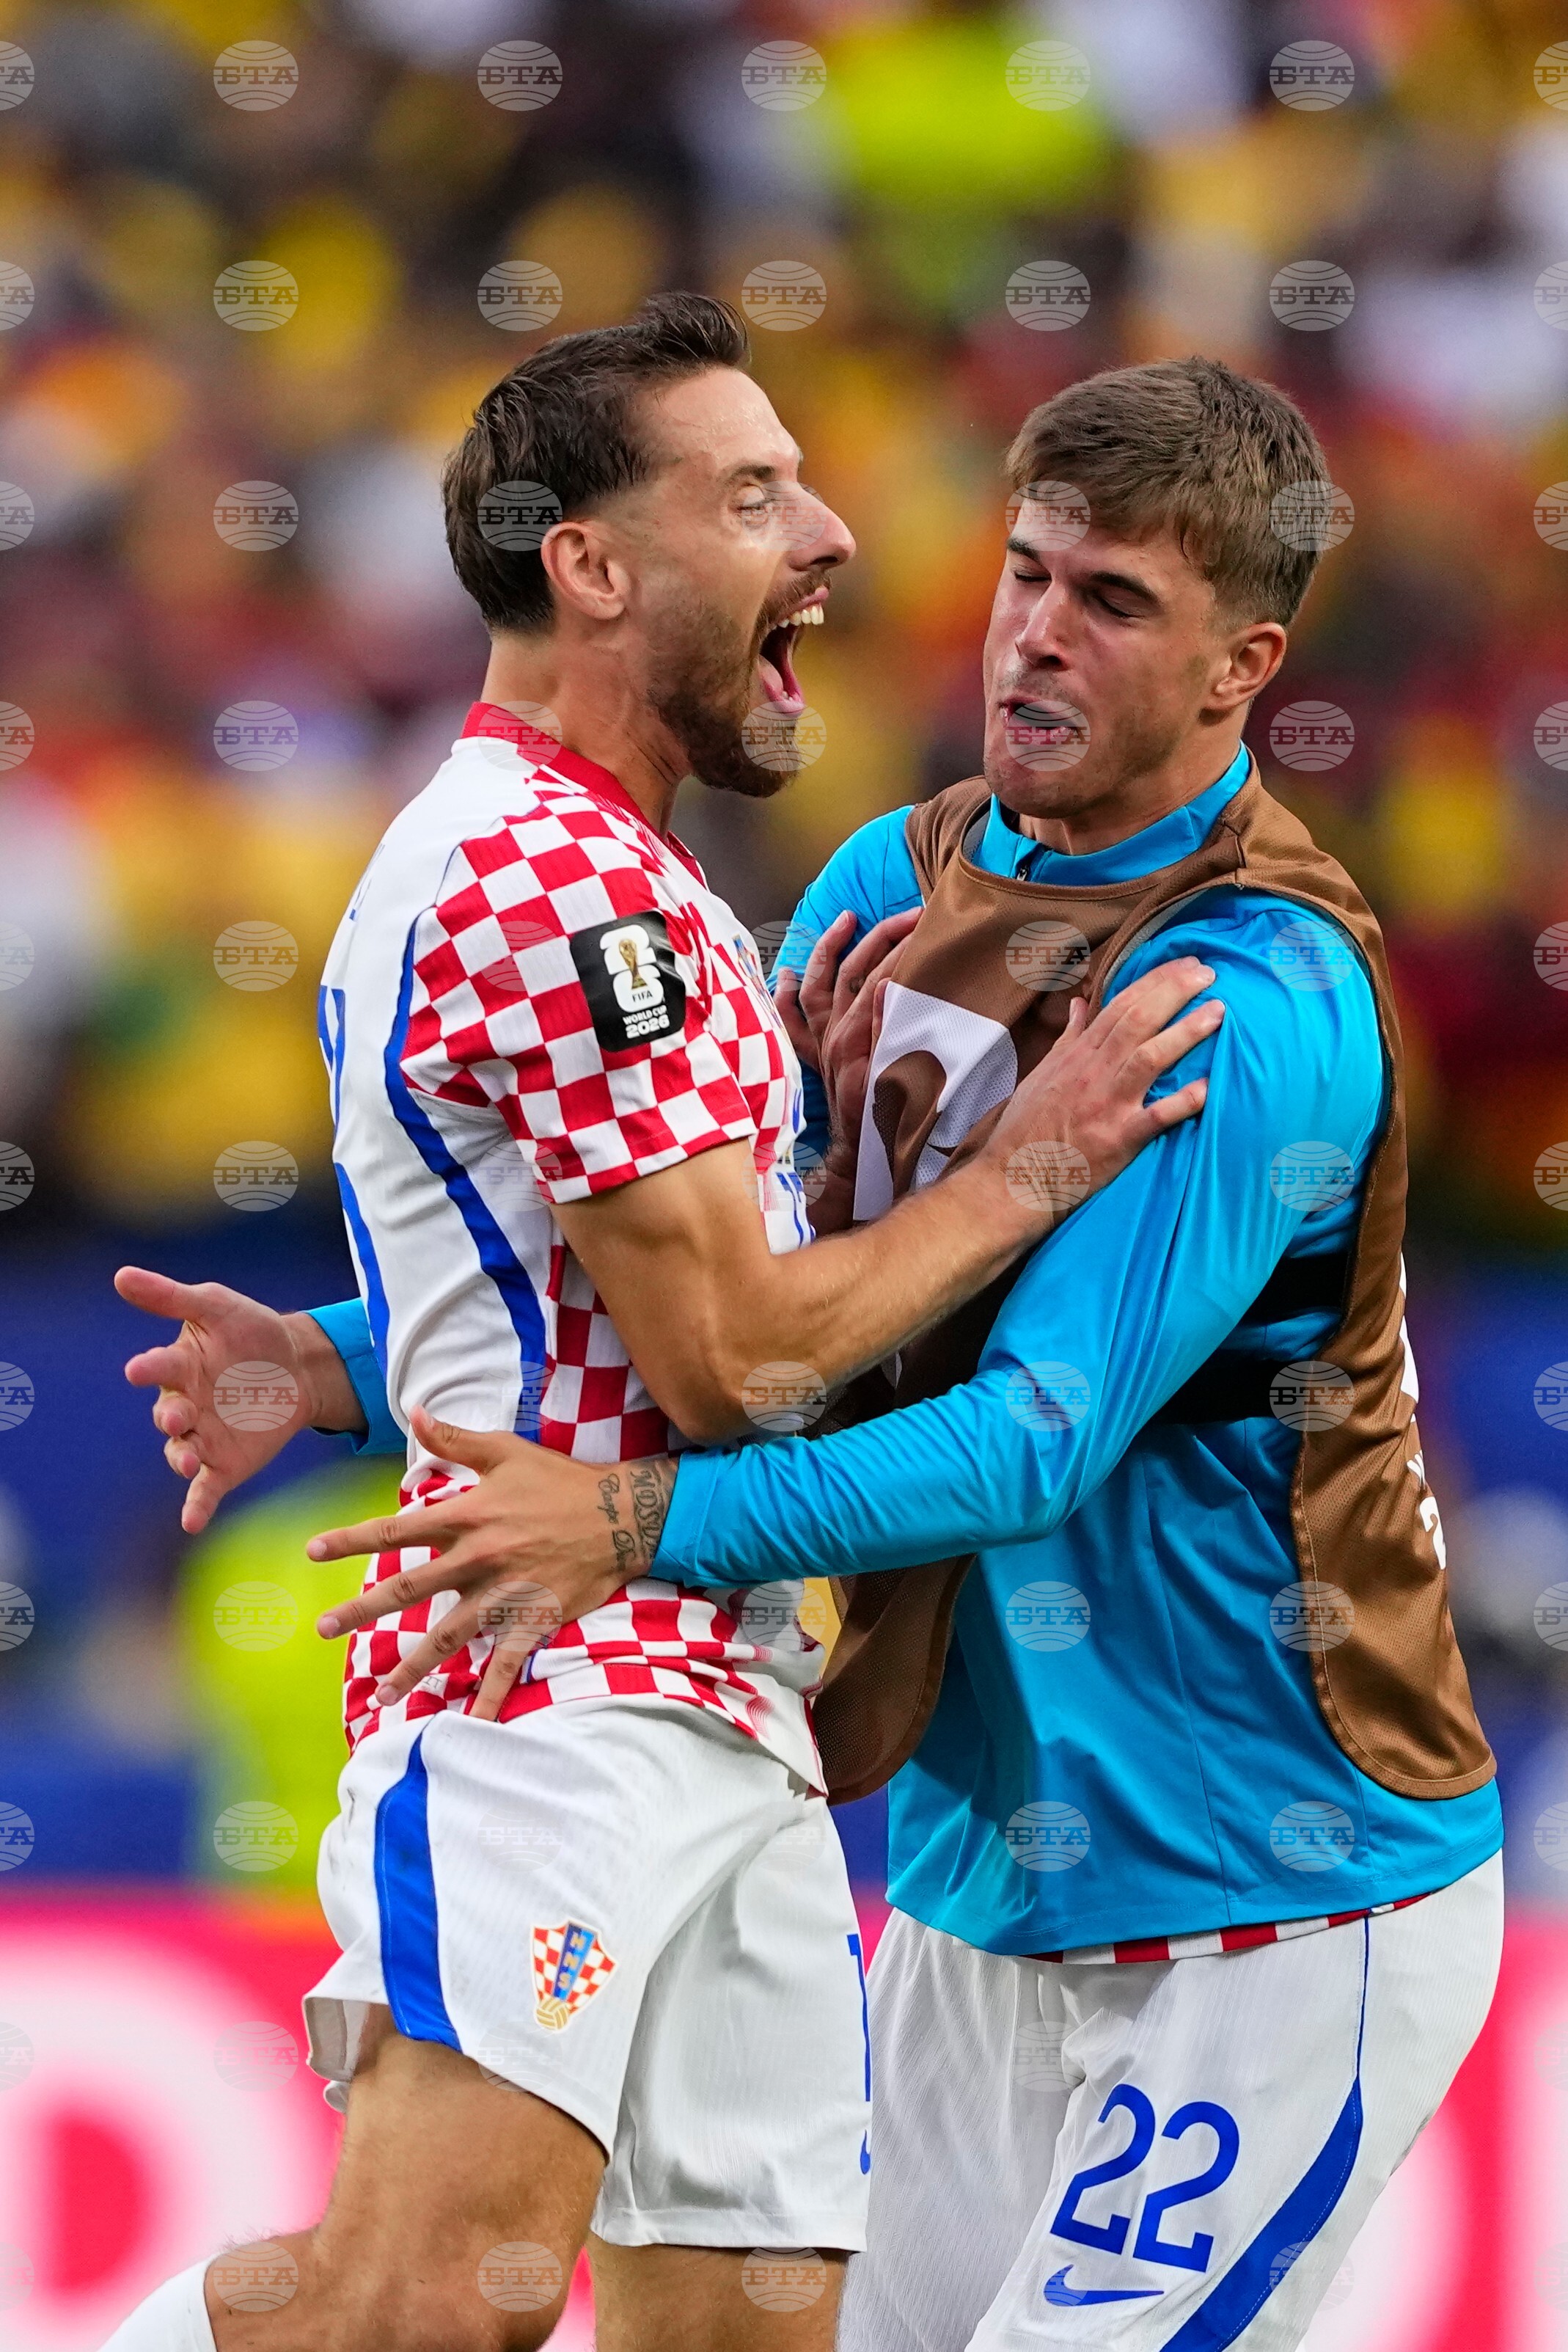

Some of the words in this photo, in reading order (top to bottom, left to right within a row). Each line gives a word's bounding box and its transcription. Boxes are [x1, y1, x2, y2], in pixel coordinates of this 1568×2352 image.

[632, 990, 653, 1002] FIFA
[622, 1009, 653, 1026] WORLD
[625, 1014, 670, 1039] 2026
[1049, 2083, 1240, 2273] 22
